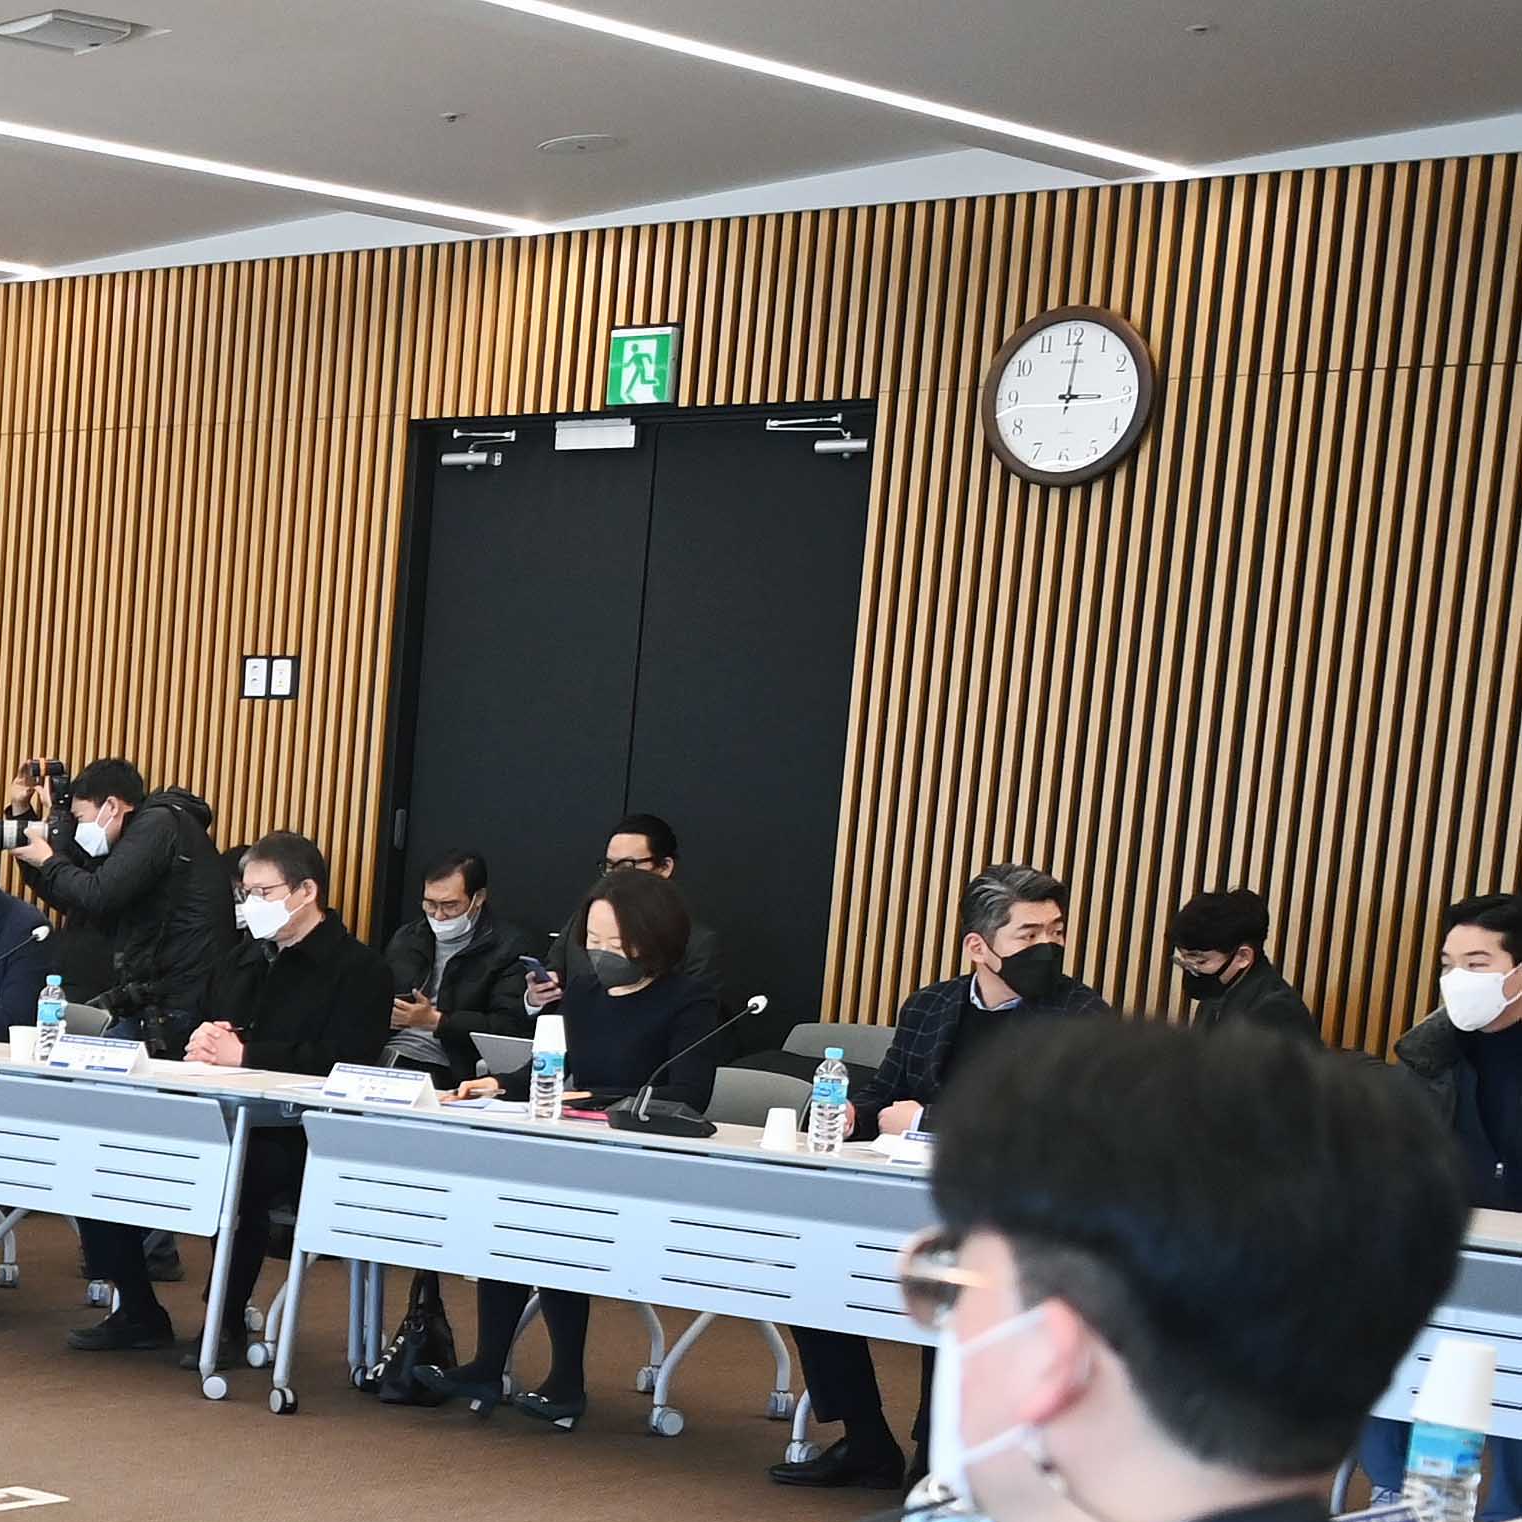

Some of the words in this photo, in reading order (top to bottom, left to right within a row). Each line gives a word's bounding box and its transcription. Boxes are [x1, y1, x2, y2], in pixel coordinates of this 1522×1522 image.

[1039, 335, 1053, 354] 11
[1065, 327, 1085, 347] 12
[1100, 335, 1107, 353] 1
[1016, 359, 1033, 377] 10
[1115, 354, 1127, 373] 2
[1007, 390, 1019, 409] 9
[1011, 419, 1024, 436] 8
[1108, 416, 1119, 434] 4
[1029, 442, 1043, 461] 7
[1086, 439, 1099, 458] 5
